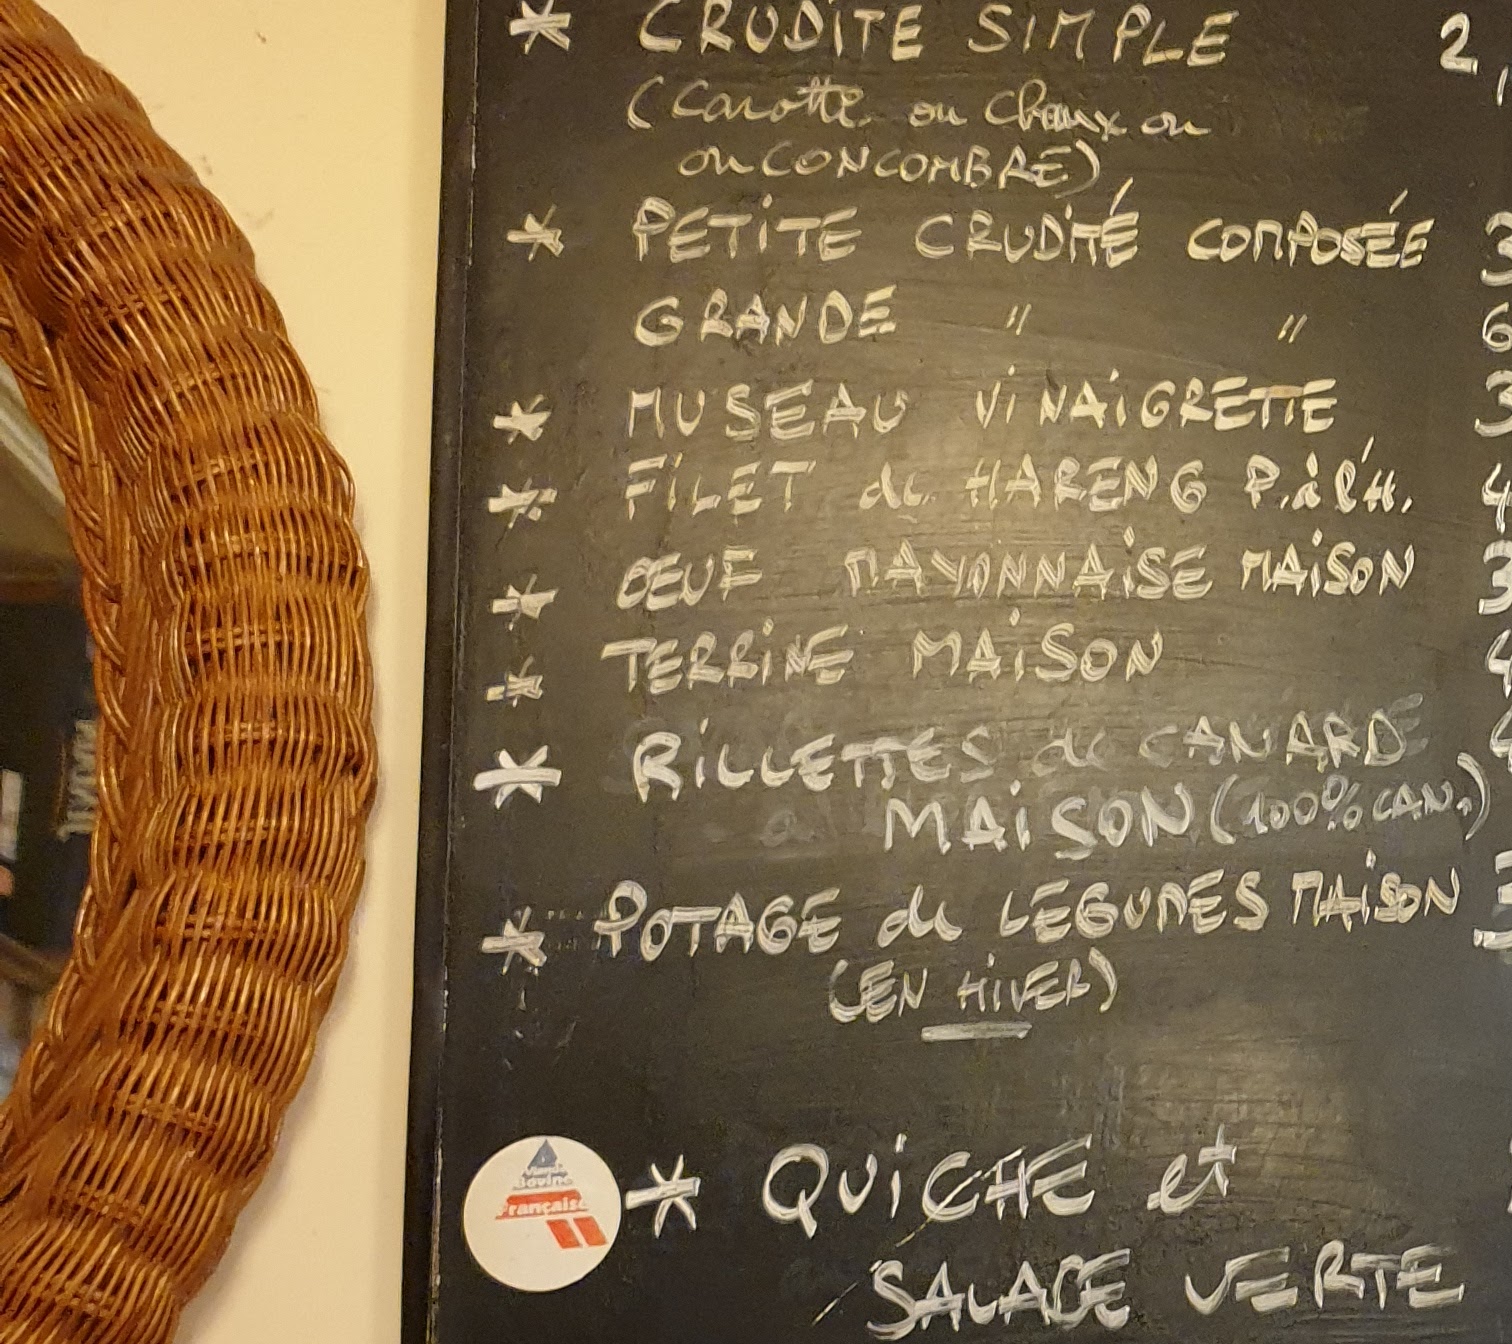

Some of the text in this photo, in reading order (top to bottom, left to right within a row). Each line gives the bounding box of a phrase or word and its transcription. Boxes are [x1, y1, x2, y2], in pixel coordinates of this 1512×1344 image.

[633, 284, 899, 347] GRANDE
[627, 385, 907, 438] MUSEAU
[965, 456, 1207, 513] HARENG
[594, 881, 846, 962] POTAGE
[867, 1243, 1465, 1341] SALADE VERTE
